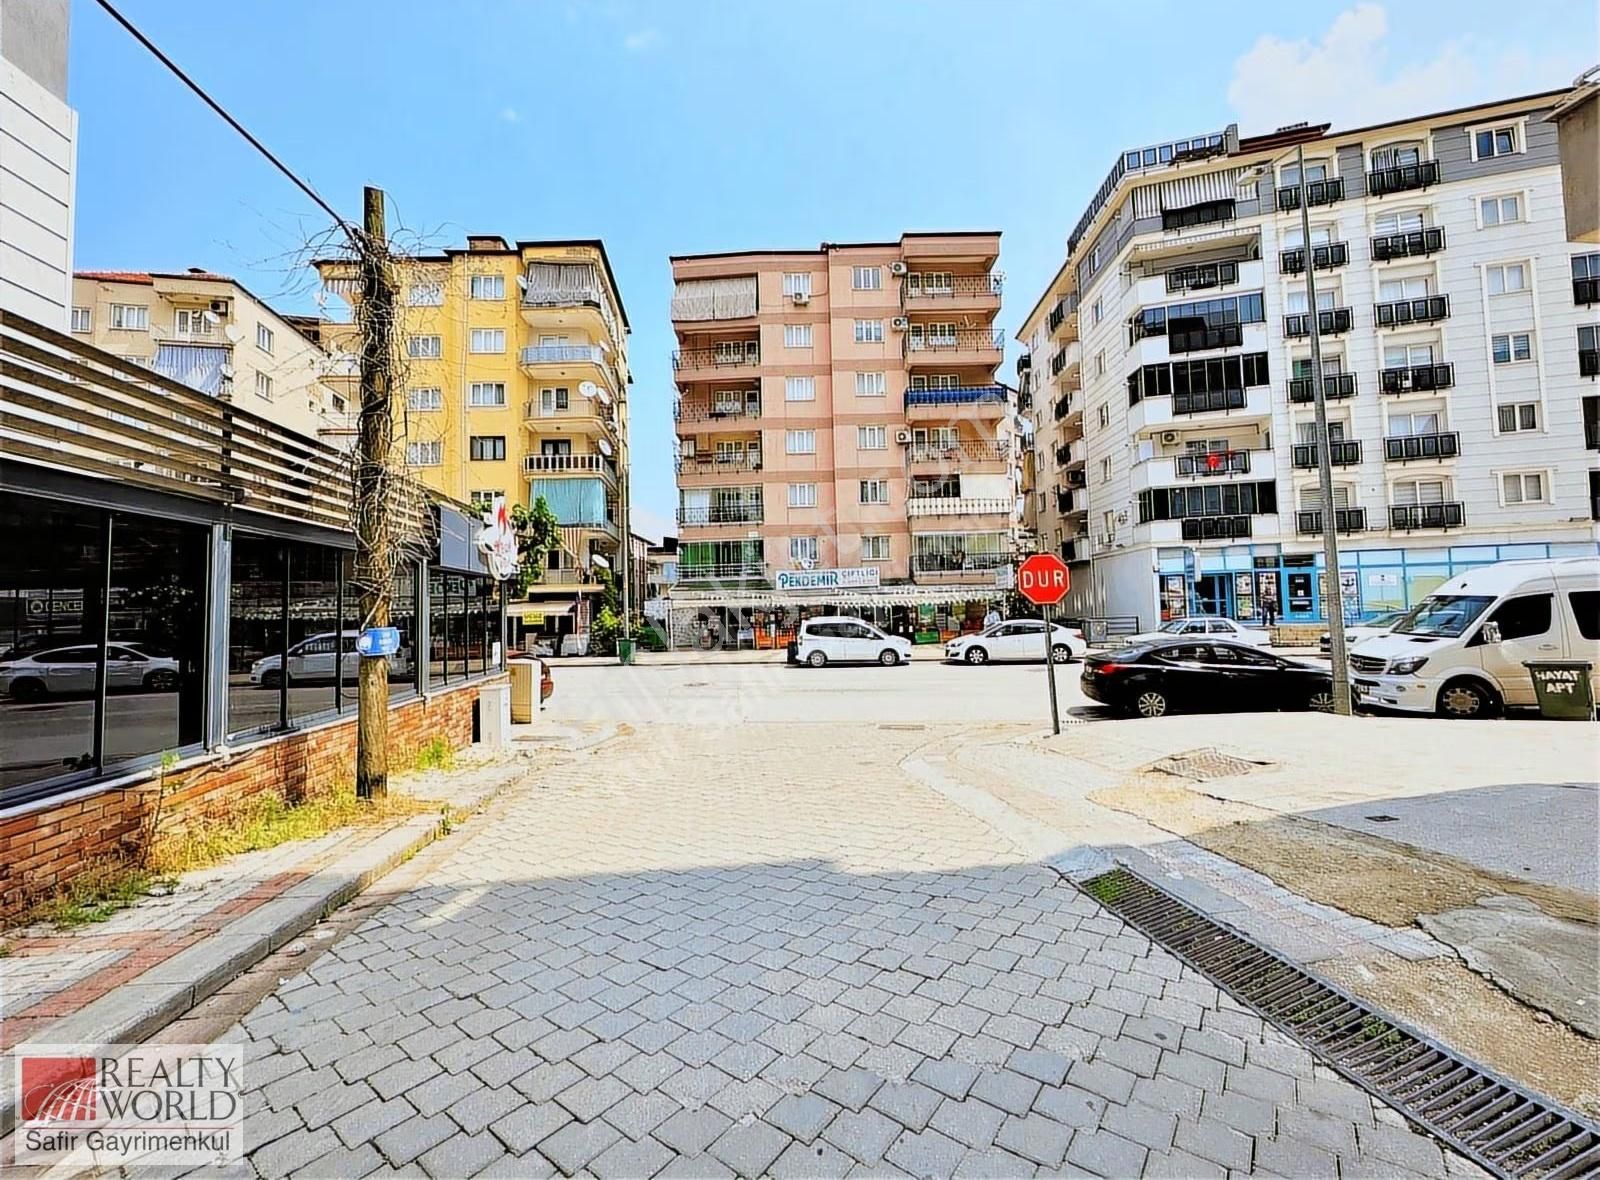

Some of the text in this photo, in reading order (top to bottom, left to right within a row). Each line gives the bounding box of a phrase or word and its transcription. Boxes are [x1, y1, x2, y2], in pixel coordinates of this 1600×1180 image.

[1022, 569, 1065, 589] DUR
[1534, 670, 1581, 681] HAYAT
[1546, 682, 1576, 694] APT
